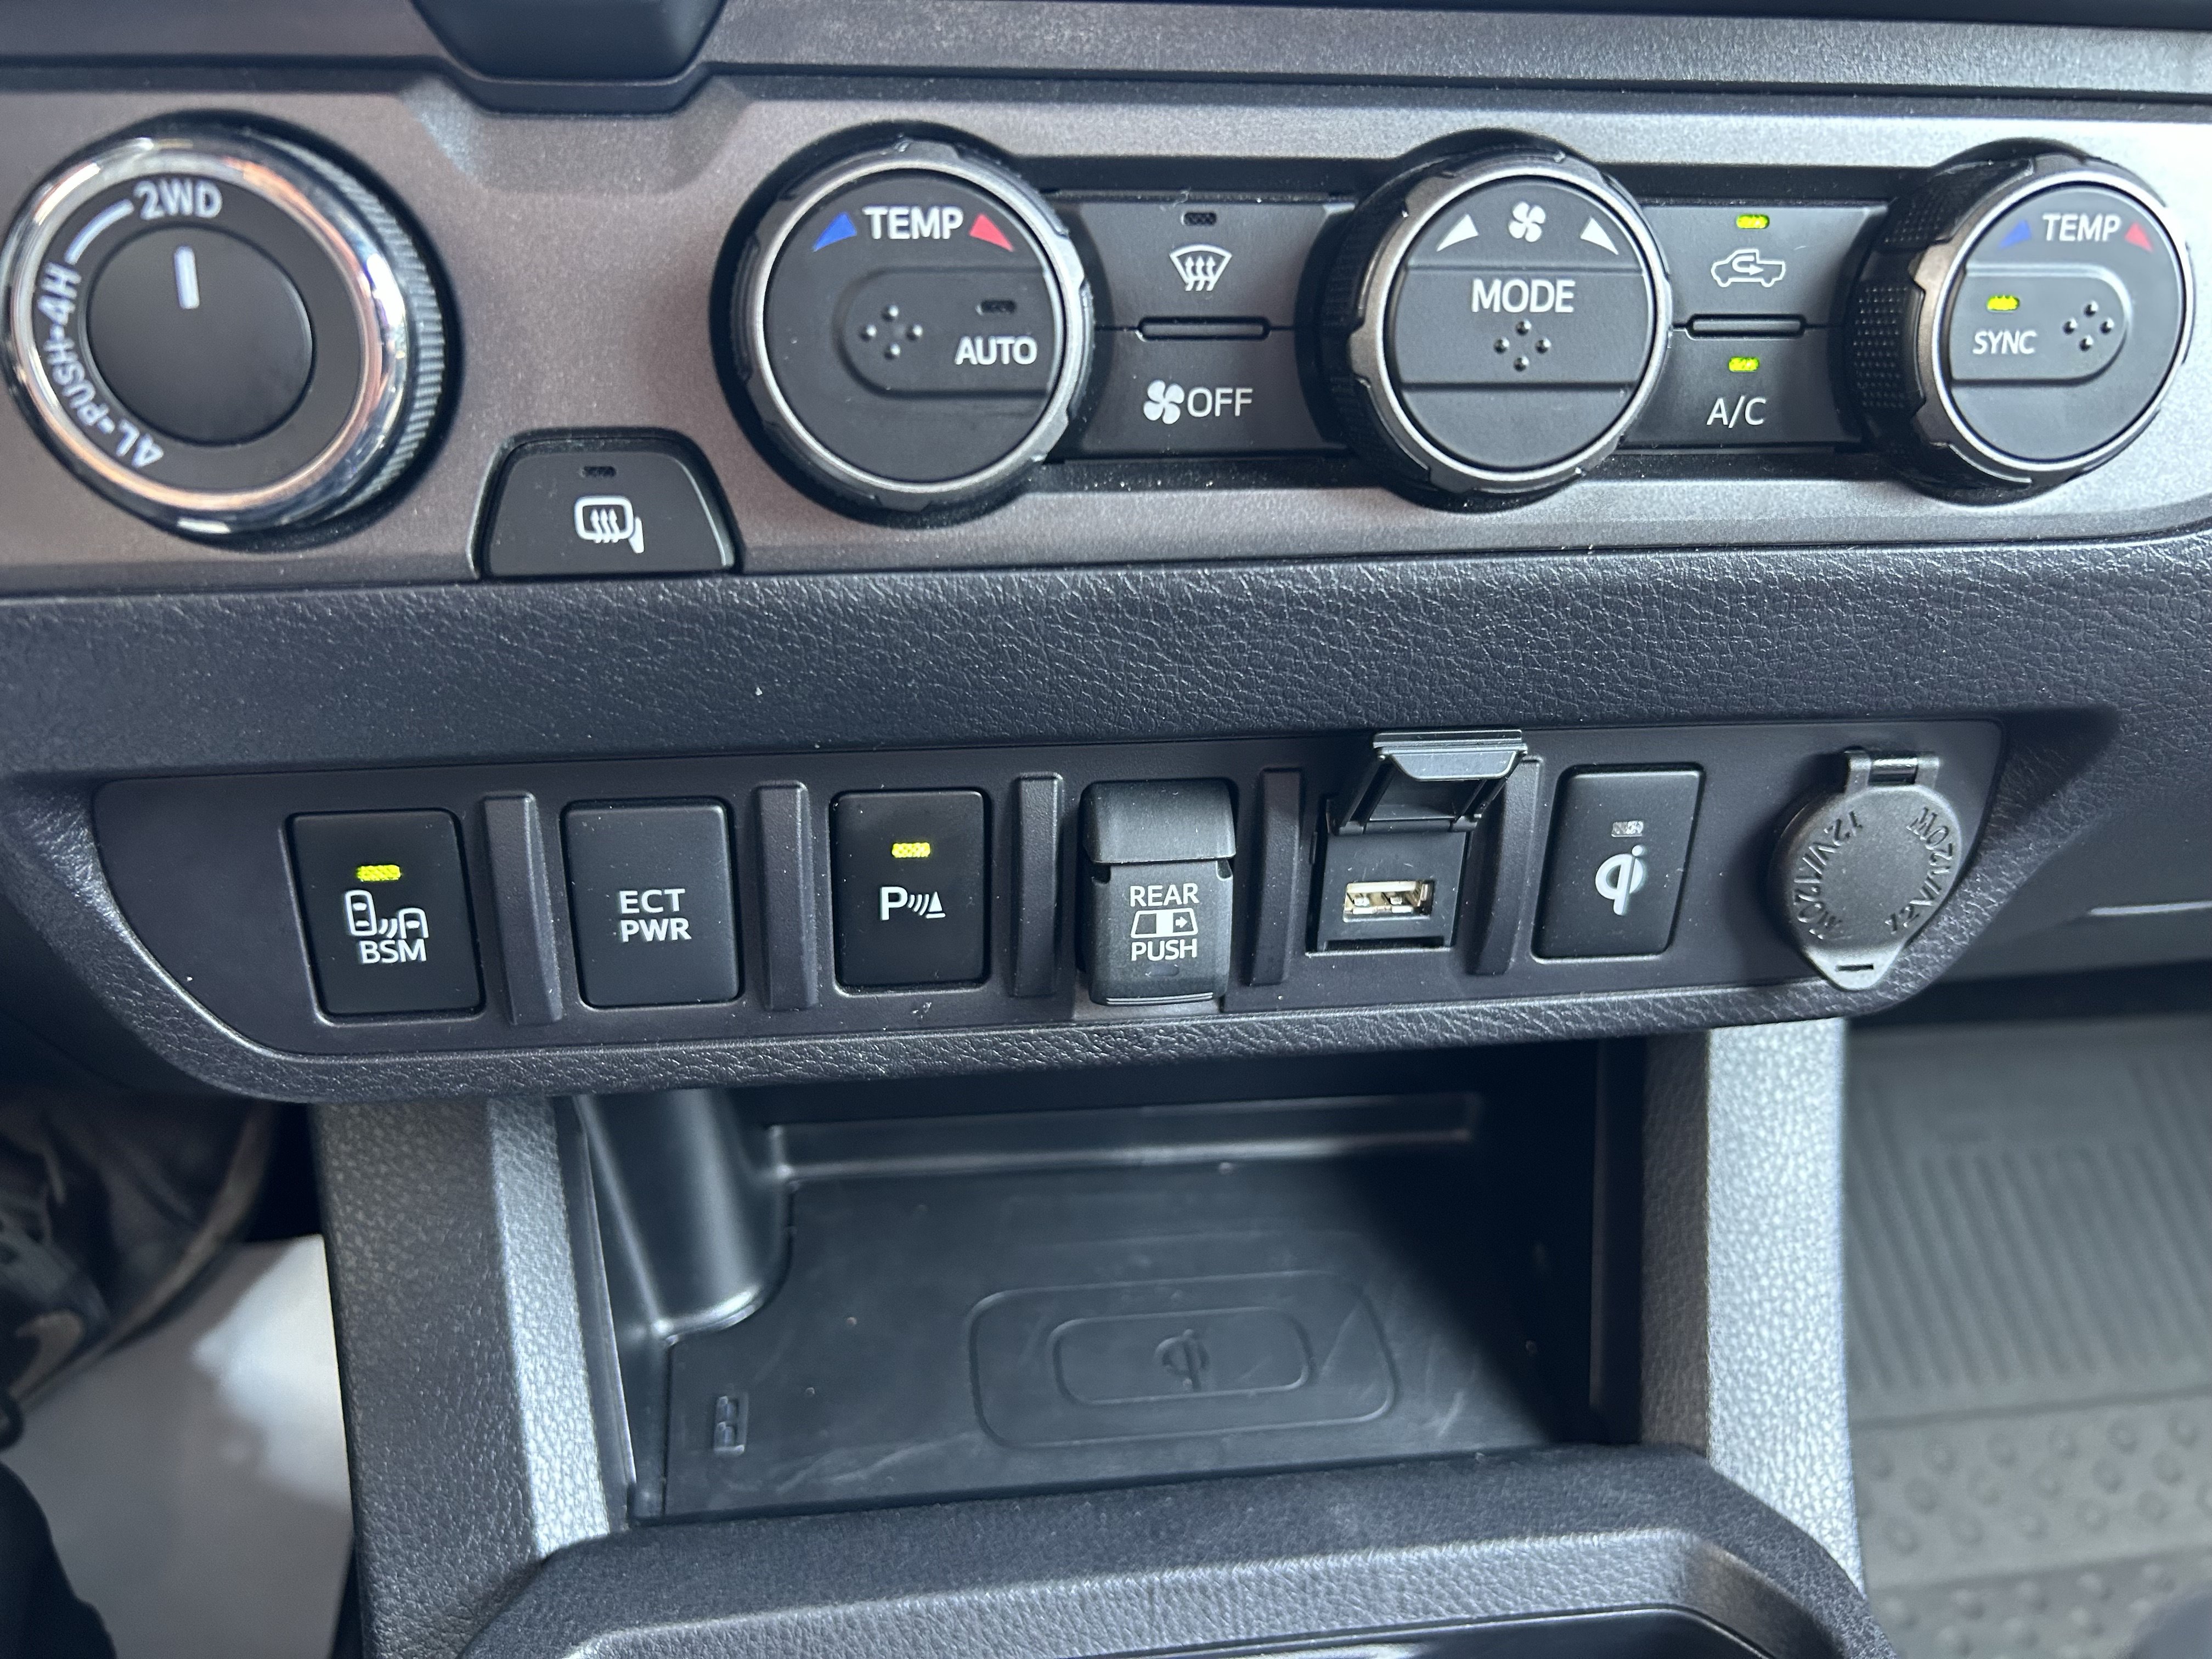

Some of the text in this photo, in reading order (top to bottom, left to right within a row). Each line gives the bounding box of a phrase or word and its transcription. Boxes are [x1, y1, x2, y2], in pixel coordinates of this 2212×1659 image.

[133, 178, 222, 221] 2WD
[862, 206, 963, 240] TEMP
[2042, 212, 2123, 242] TEMP
[1471, 278, 1576, 313] MODE
[955, 335, 1037, 366] AUTO
[1972, 329, 2038, 356] SYNC
[1187, 386, 1253, 418] OFF
[1706, 395, 1767, 428] A/C
[618, 888, 686, 915] ECT
[1129, 882, 1200, 908] REAR
[620, 917, 692, 943] PWR
[358, 939, 427, 964] BSM
[1130, 938, 1198, 962] PUSH
